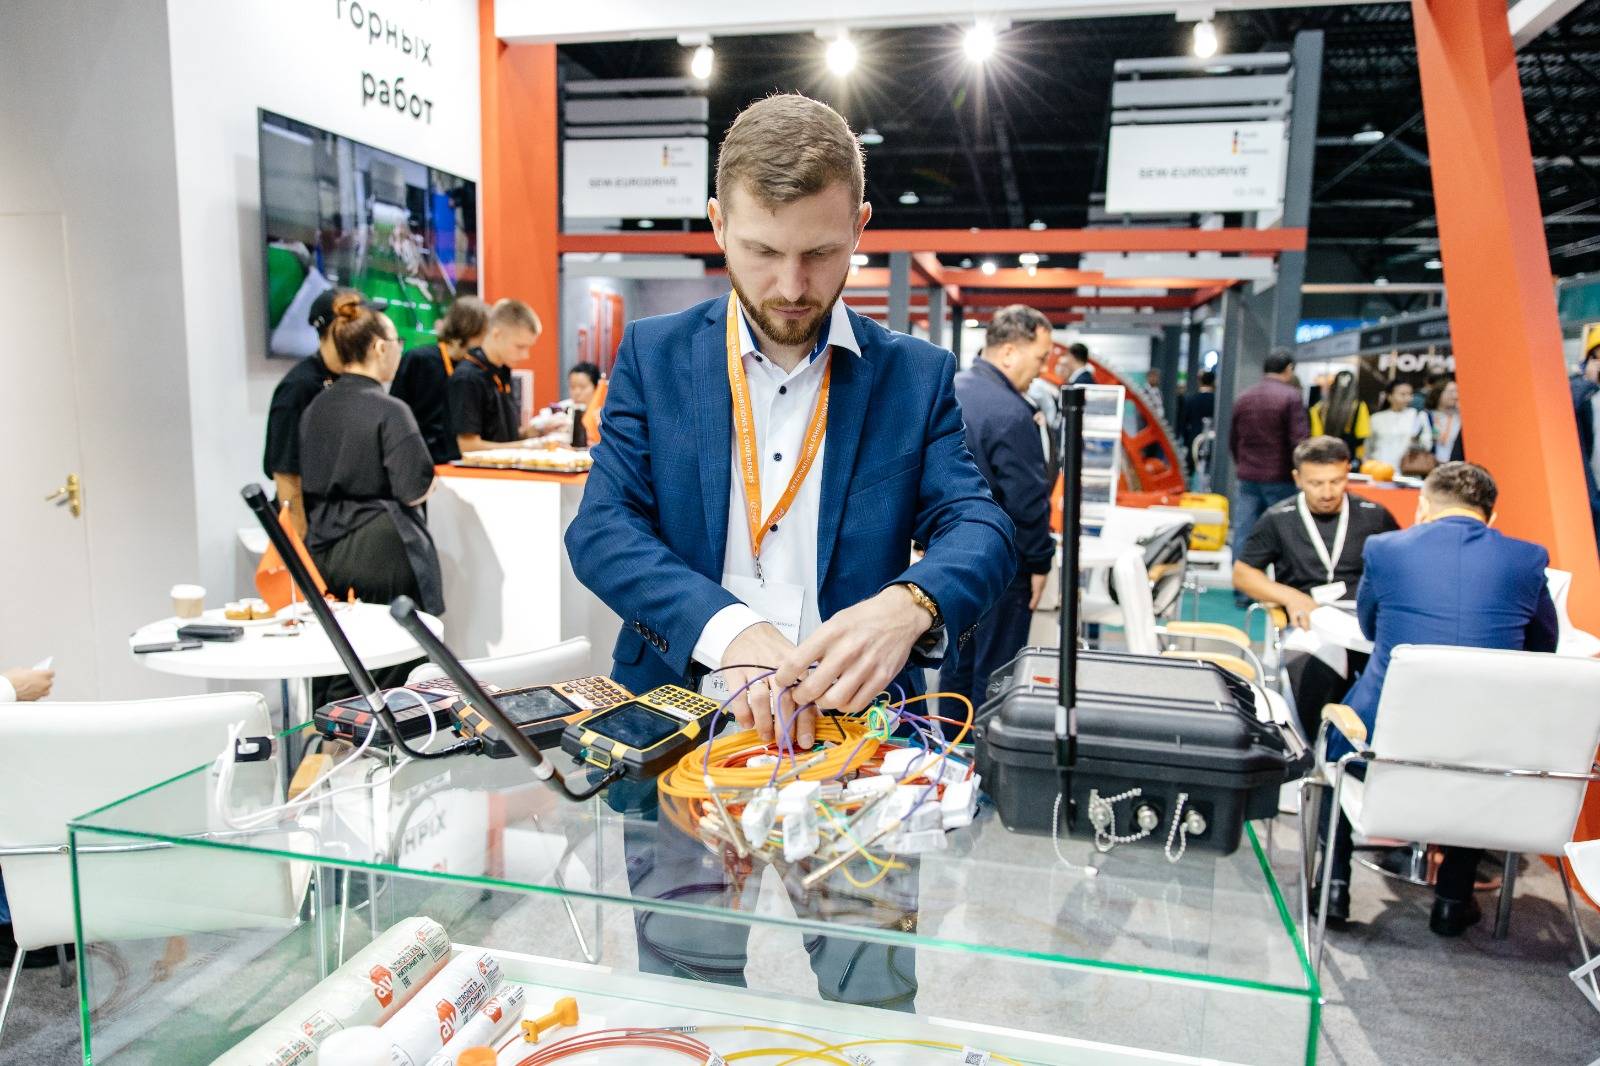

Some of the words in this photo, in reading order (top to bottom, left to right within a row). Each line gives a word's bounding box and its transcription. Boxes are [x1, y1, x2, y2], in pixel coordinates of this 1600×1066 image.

[336, 0, 432, 67] горных
[361, 70, 433, 125] работ
[736, 383, 749, 427] EXHIBITIONS
[743, 434, 755, 484] CONFERENCES
[455, 984, 477, 1008] NITRONIT
[460, 988, 483, 1016] НИТРОНИТ
